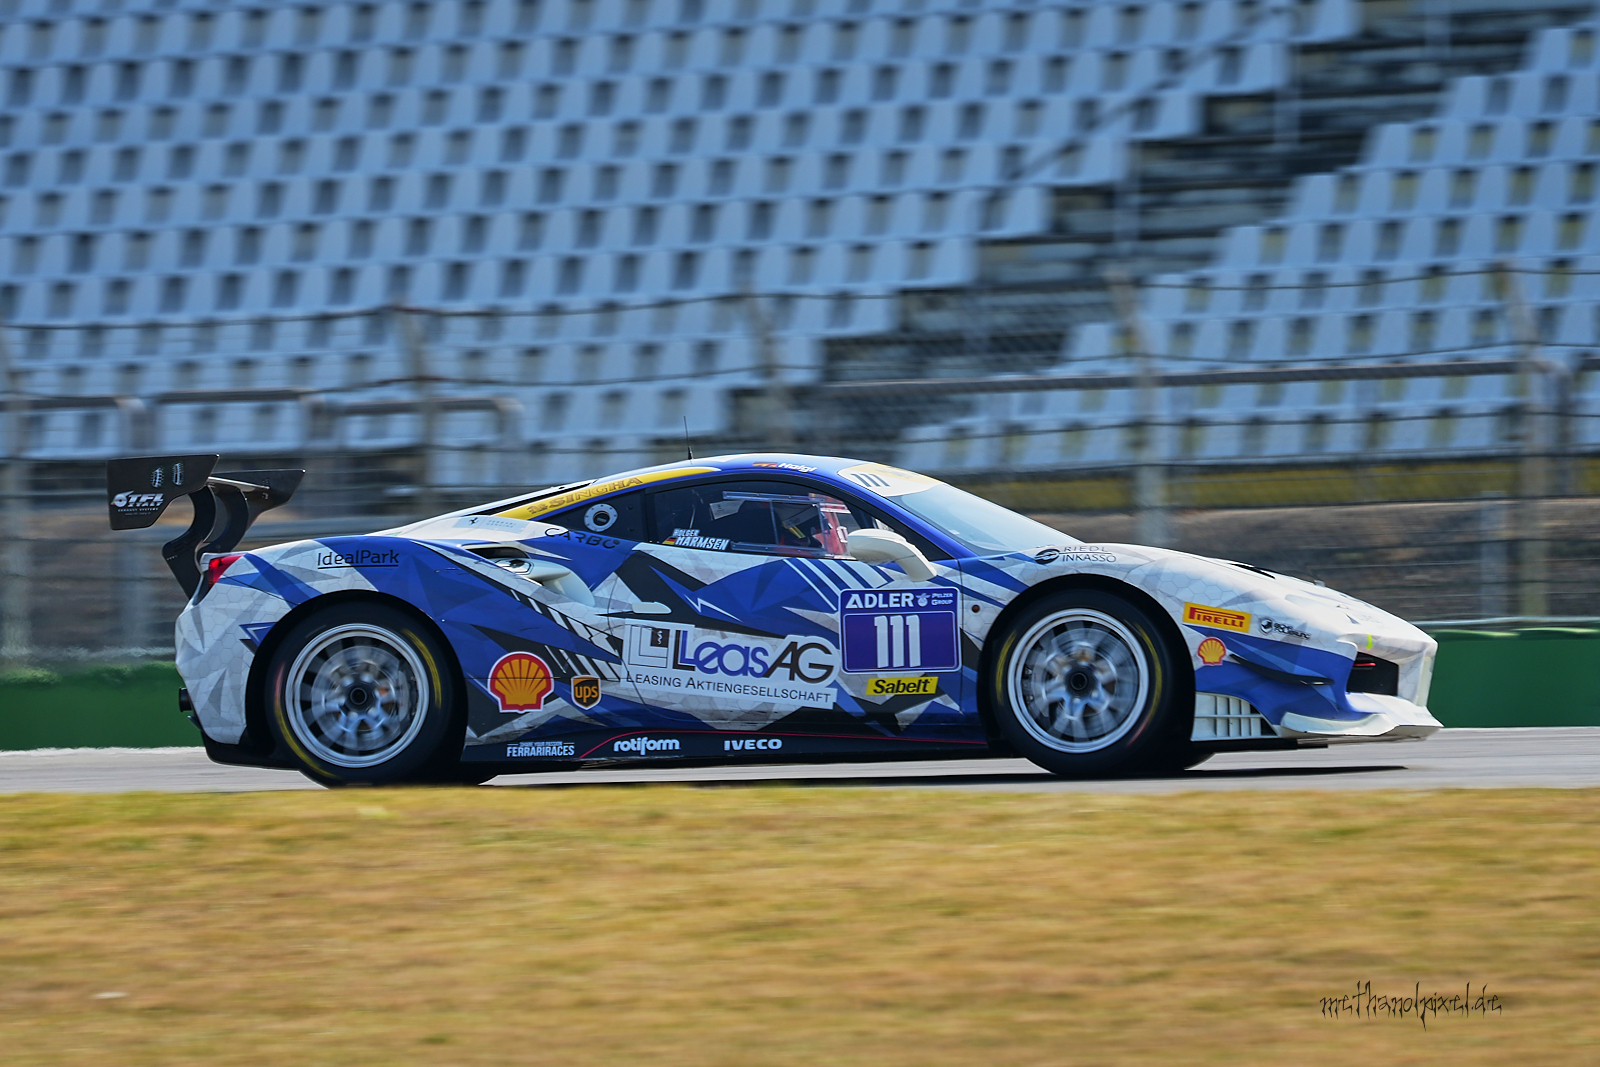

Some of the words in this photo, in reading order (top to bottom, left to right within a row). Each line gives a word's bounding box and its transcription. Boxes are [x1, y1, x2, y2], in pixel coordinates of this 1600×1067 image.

[851, 473, 890, 488] 111
[549, 477, 643, 509] SINGHA
[675, 536, 730, 551] HARMSEN
[317, 549, 400, 566] IdealPark
[1062, 553, 1117, 563] INKASSO
[845, 592, 915, 609] ADLER
[1188, 606, 1246, 628] PIRELLI
[873, 614, 922, 669] 111
[574, 686, 599, 703] ups
[626, 670, 682, 688] LEASING
[685, 677, 831, 703] AKTIENGESELLSCHAFT
[872, 678, 932, 695] Sabelt
[506, 745, 575, 758] FERRARIRACES
[613, 737, 681, 756] rotiform
[723, 738, 783, 751] IVECO
